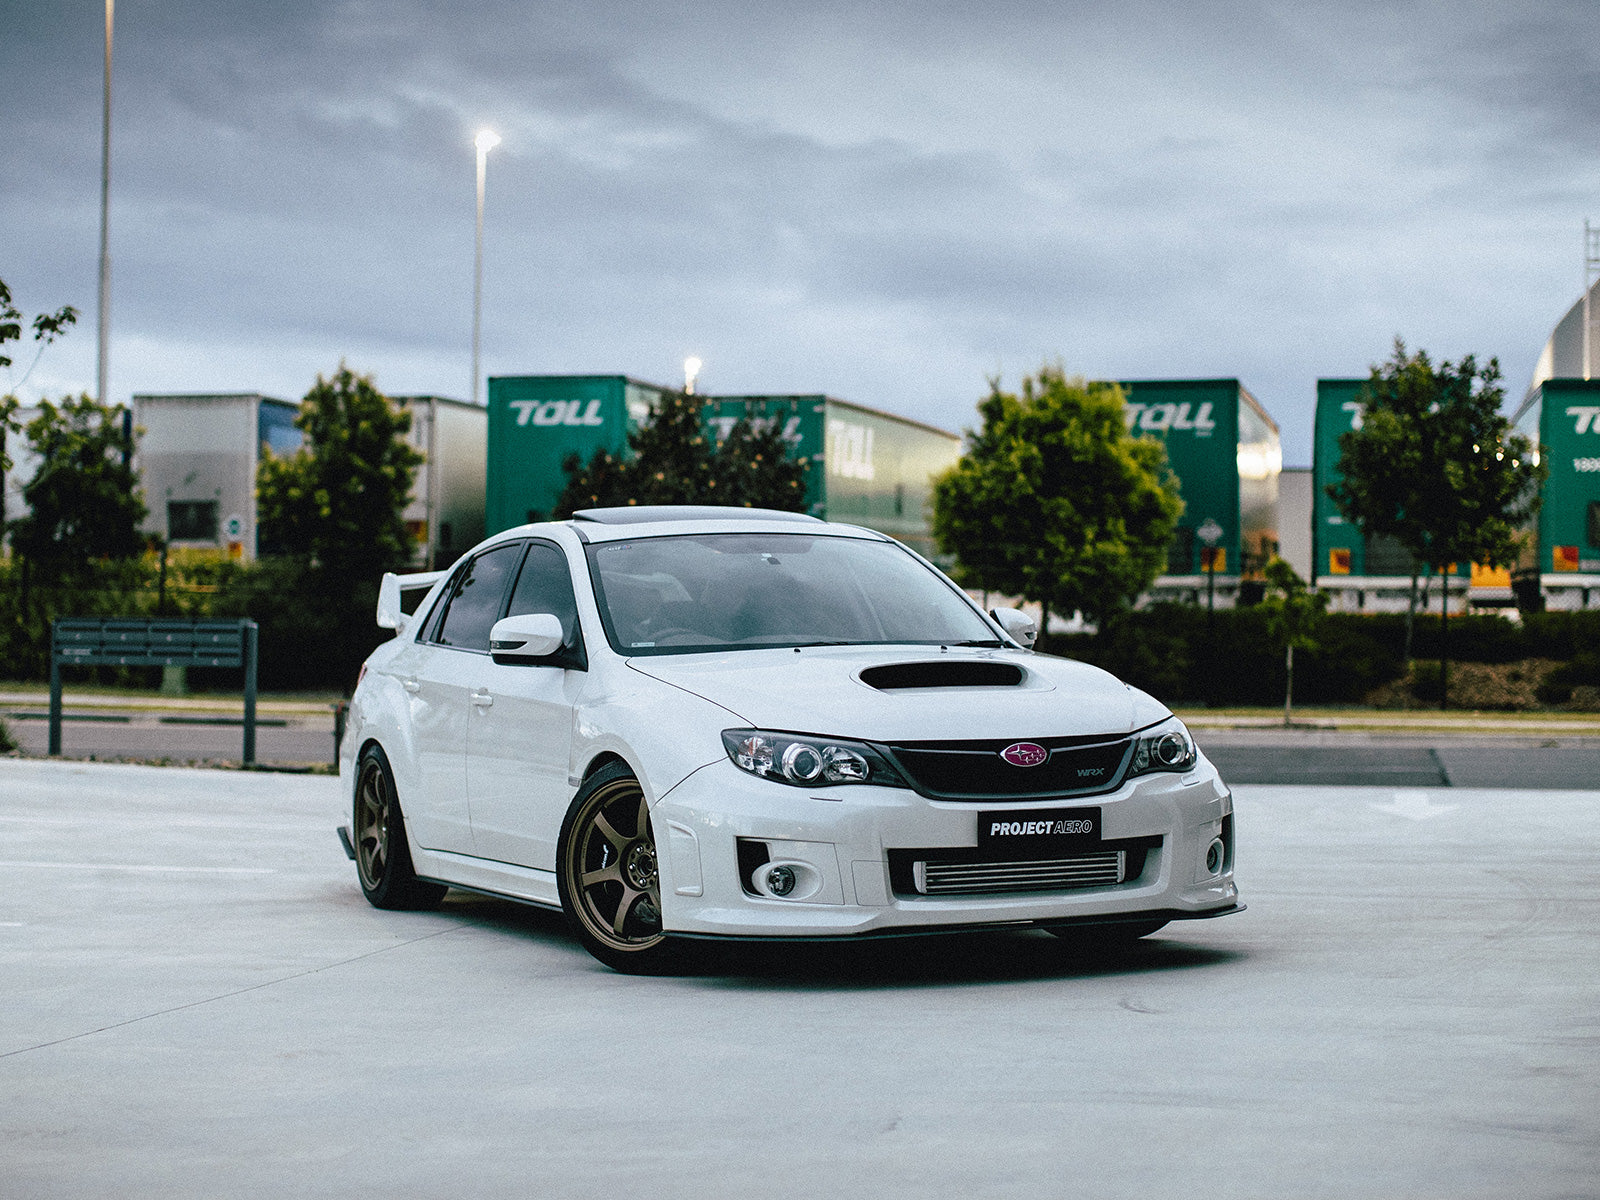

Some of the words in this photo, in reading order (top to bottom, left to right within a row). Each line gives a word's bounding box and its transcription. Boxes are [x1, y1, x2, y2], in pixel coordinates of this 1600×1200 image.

[508, 399, 604, 427] TOLL
[1122, 402, 1215, 430] TOLL
[1077, 768, 1104, 777] WRX
[990, 821, 1054, 836] PROJECT
[1053, 819, 1093, 834] AERO
